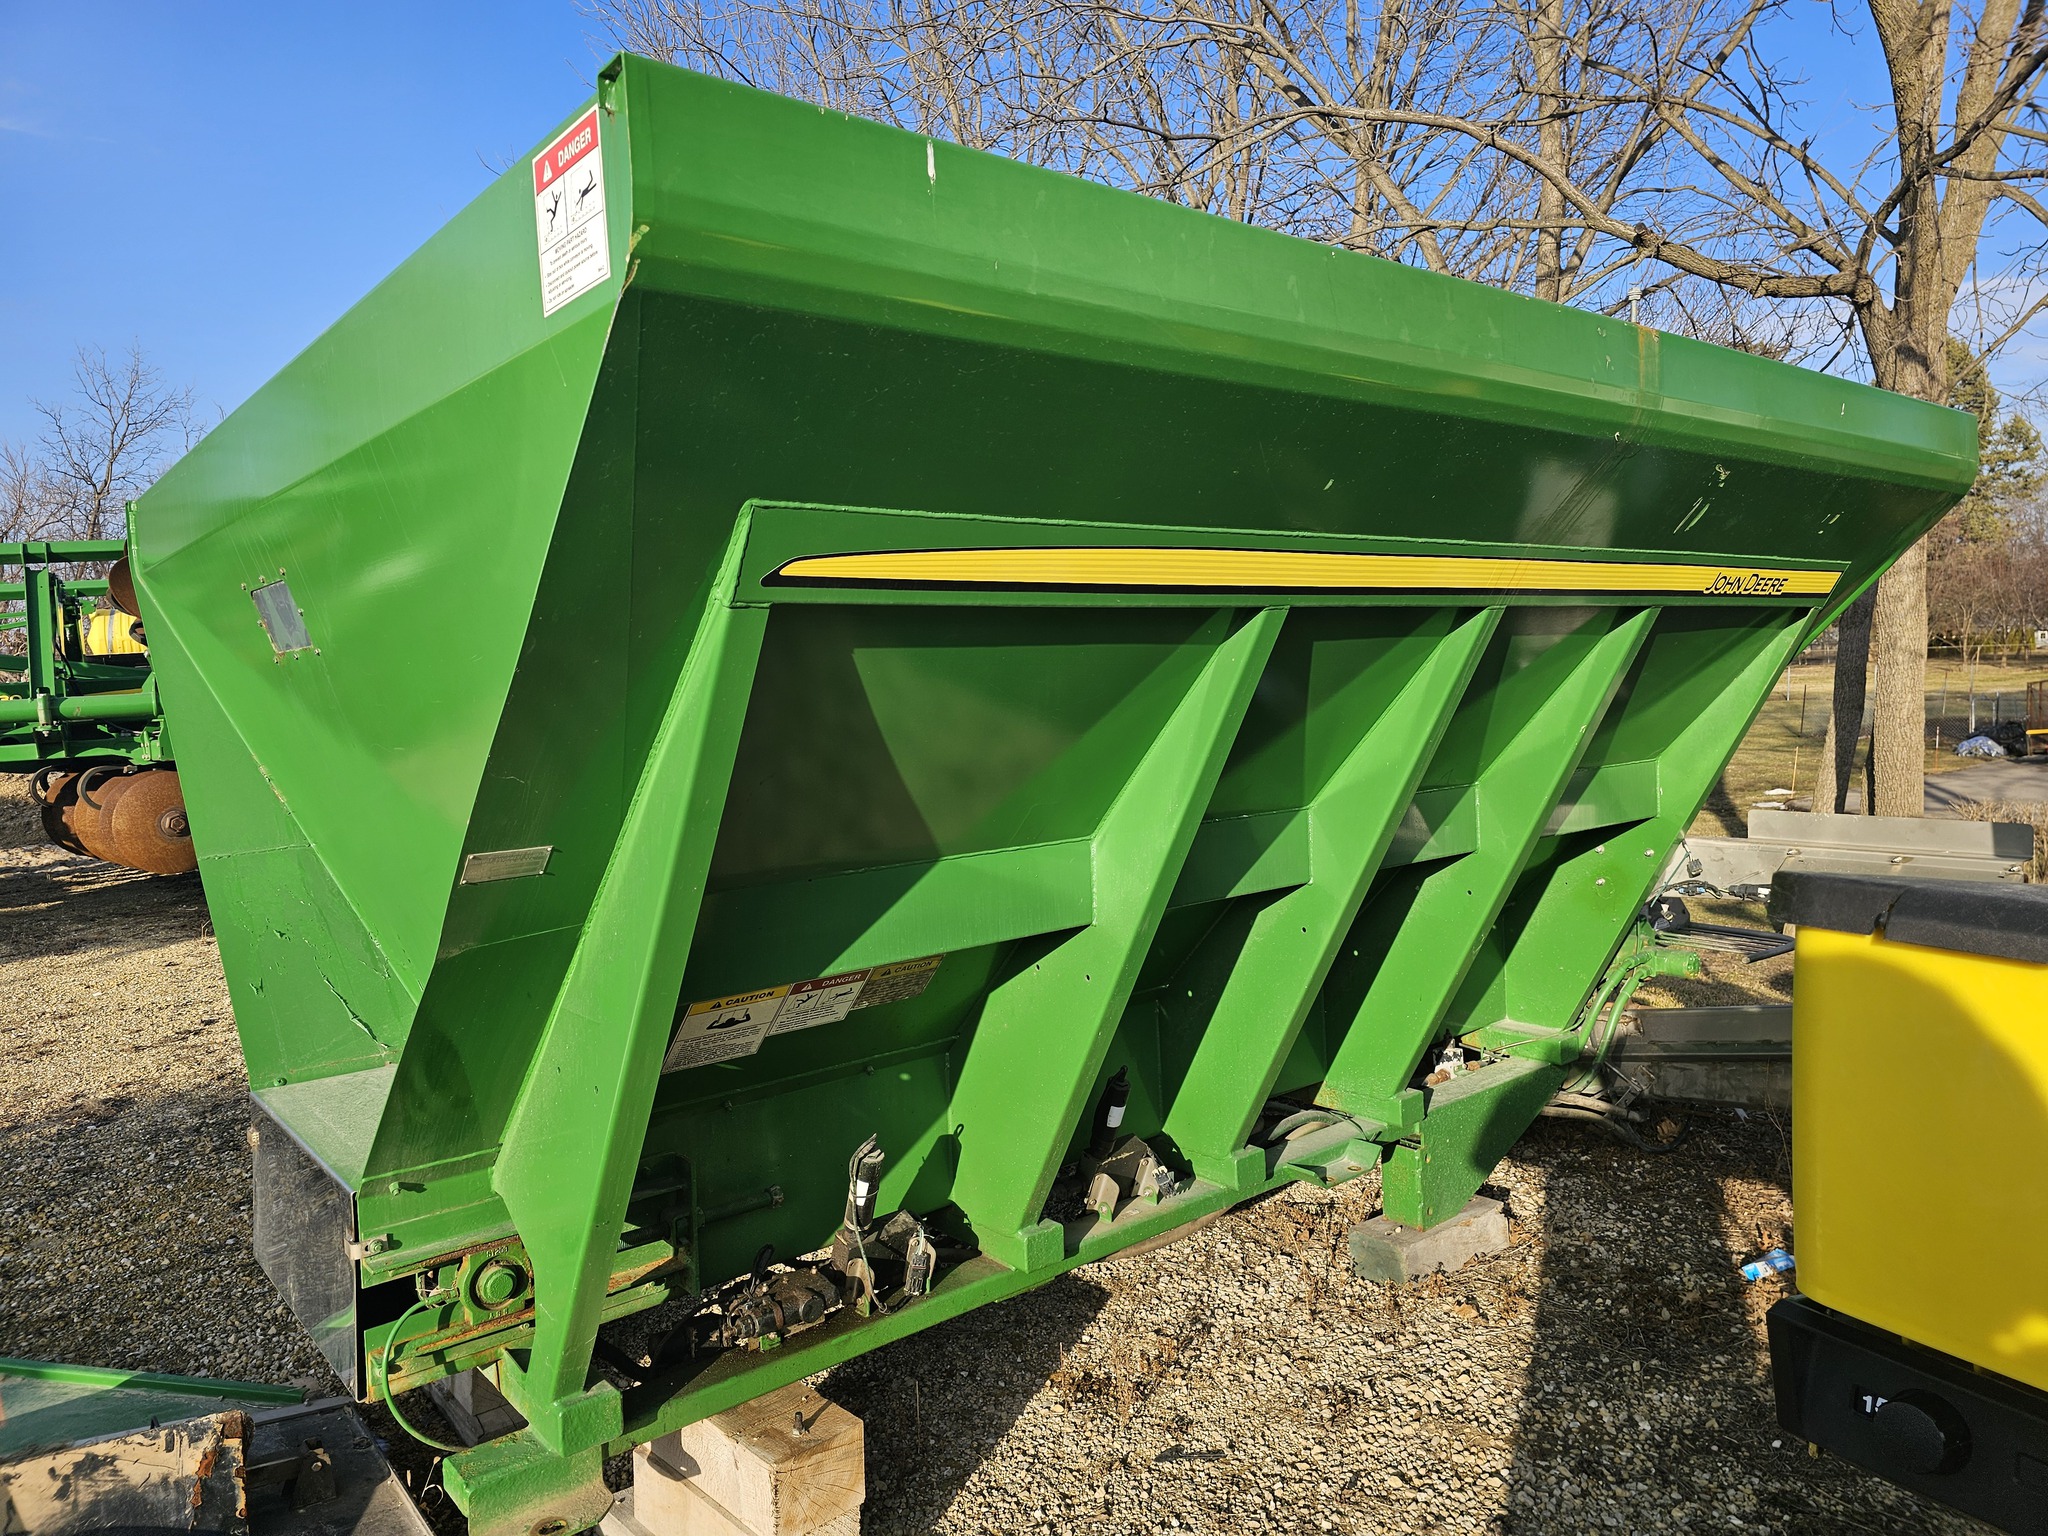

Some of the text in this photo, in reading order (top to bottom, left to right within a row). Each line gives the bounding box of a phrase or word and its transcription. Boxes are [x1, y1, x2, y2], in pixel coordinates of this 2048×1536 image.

[557, 126, 592, 168] DANGER
[1704, 572, 1789, 593] JOHN DEERE
[894, 960, 933, 973] CAUTION
[821, 973, 862, 987] DANGER
[725, 990, 775, 1006] CAUTION
